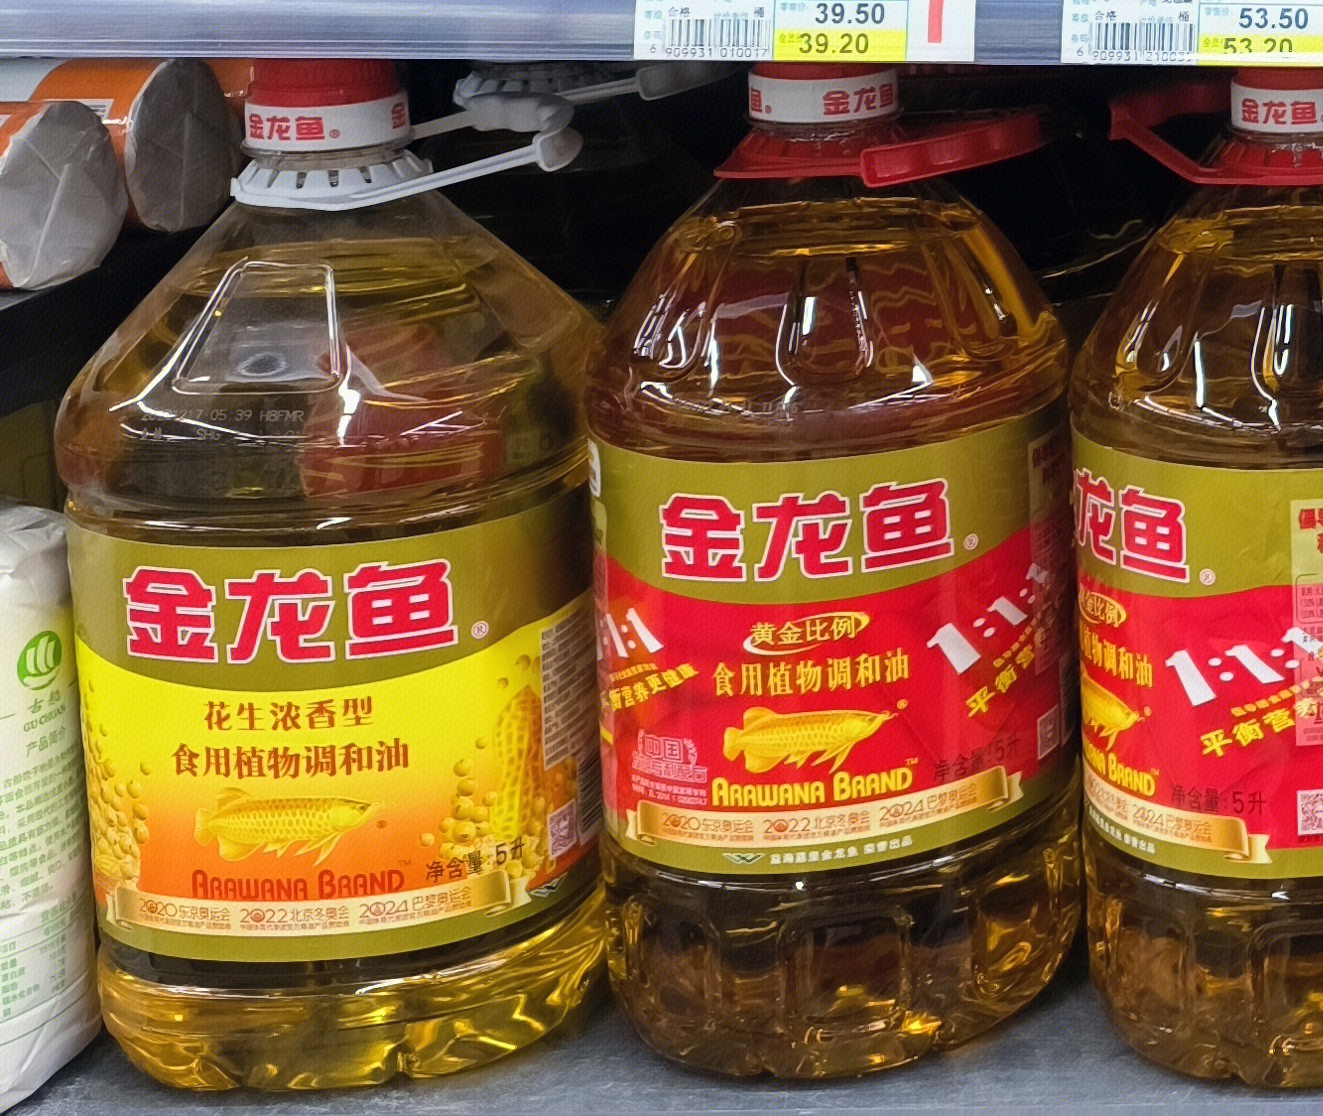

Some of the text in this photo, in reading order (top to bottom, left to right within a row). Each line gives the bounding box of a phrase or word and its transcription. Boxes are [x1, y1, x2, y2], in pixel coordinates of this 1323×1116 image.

[668, 7, 691, 18] 合格
[815, 3, 885, 25] 39.50
[1095, 11, 1117, 22] 合格
[1239, 8, 1309, 30] 53.50
[666, 46, 768, 58] 909931 010017
[799, 33, 869, 54] 39.20
[1092, 50, 1138, 62] 909931
[1223, 37, 1293, 55] 53.20
[822, 82, 896, 117] 金龙鱼
[1240, 98, 1319, 126] 金龙鱼
[249, 114, 325, 141] 金龙鱼
[659, 478, 954, 582] 金龙鱼
[123, 558, 458, 664] 金龙鱼
[750, 616, 857, 646] 黄金比例
[712, 653, 910, 697] 食用植物调和油
[23, 704, 66, 732] GU CHUAN
[203, 697, 373, 731] 花生浓香型
[26, 725, 66, 758] 产品简介
[172, 738, 410, 779] 食用植物调和油
[711, 777, 825, 807] ARAWANA
[833, 767, 914, 801] BRAND
[1108, 759, 1156, 797] BRAND
[1171, 786, 1267, 815] 净含量:5升
[425, 838, 526, 884] 净含量:5升
[191, 869, 406, 900] ARAWANA BRAND
[240, 896, 350, 924] 2022北京冬奥会
